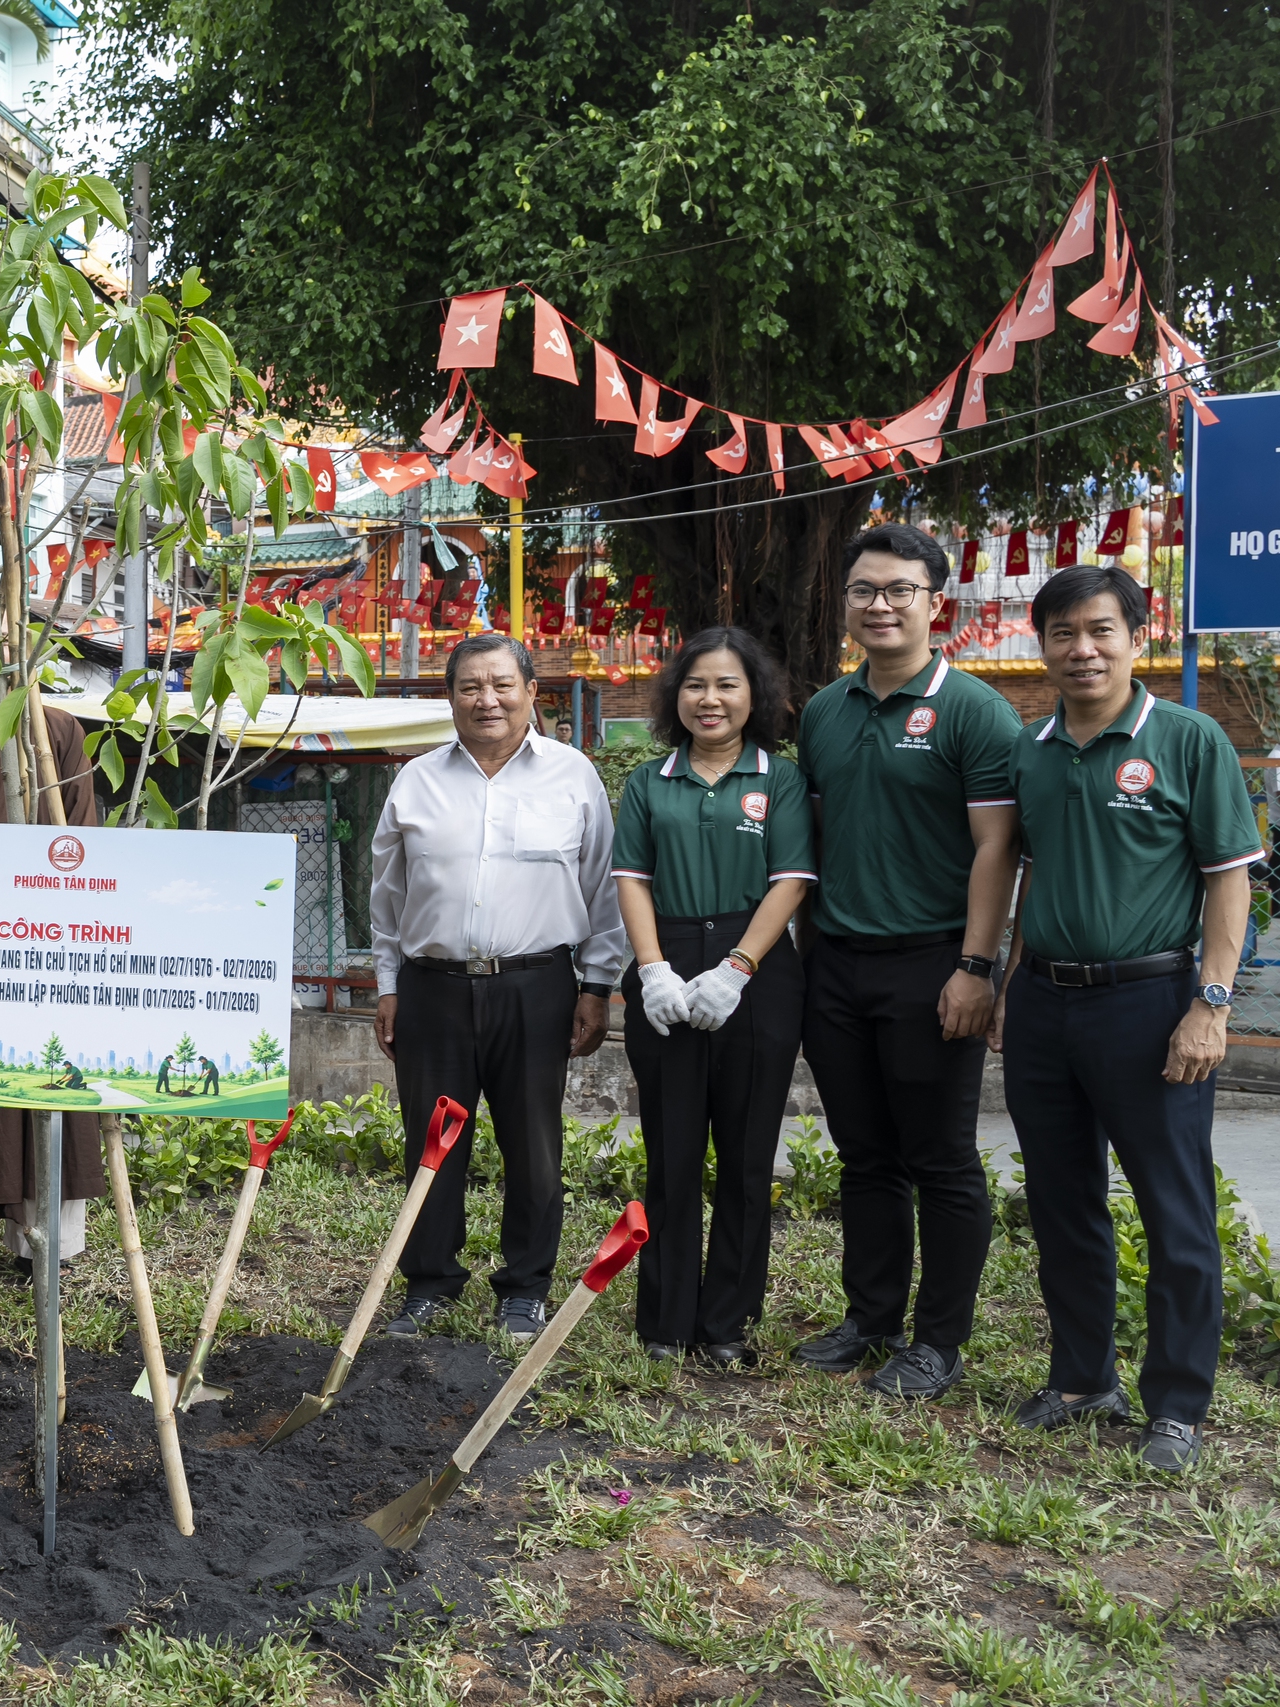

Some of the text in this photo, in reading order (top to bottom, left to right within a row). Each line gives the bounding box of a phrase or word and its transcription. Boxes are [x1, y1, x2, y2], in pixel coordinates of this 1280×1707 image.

[1230, 530, 1264, 560] HỌ
[14, 873, 117, 894] PHƯỜNG TÂN ĐỊNH
[68, 920, 132, 944] TRÌNH
[24, 947, 42, 970] TÊN
[46, 946, 66, 972] CHỦ
[69, 952, 90, 977] TỊCH
[94, 947, 107, 974] HỒ
[110, 951, 127, 974] CHÍ
[130, 955, 156, 975] MINH
[160, 956, 212, 977] (02/7/1976
[223, 958, 276, 982] 02/7/2026)
[28, 979, 46, 1008] LẬP
[51, 980, 89, 1004] PHƯỜNG
[93, 982, 111, 1006] TÂN
[115, 987, 139, 1010] ĐỊNH
[143, 988, 195, 1010] (01/7/2025
[206, 991, 259, 1014] 01/7/2026)
